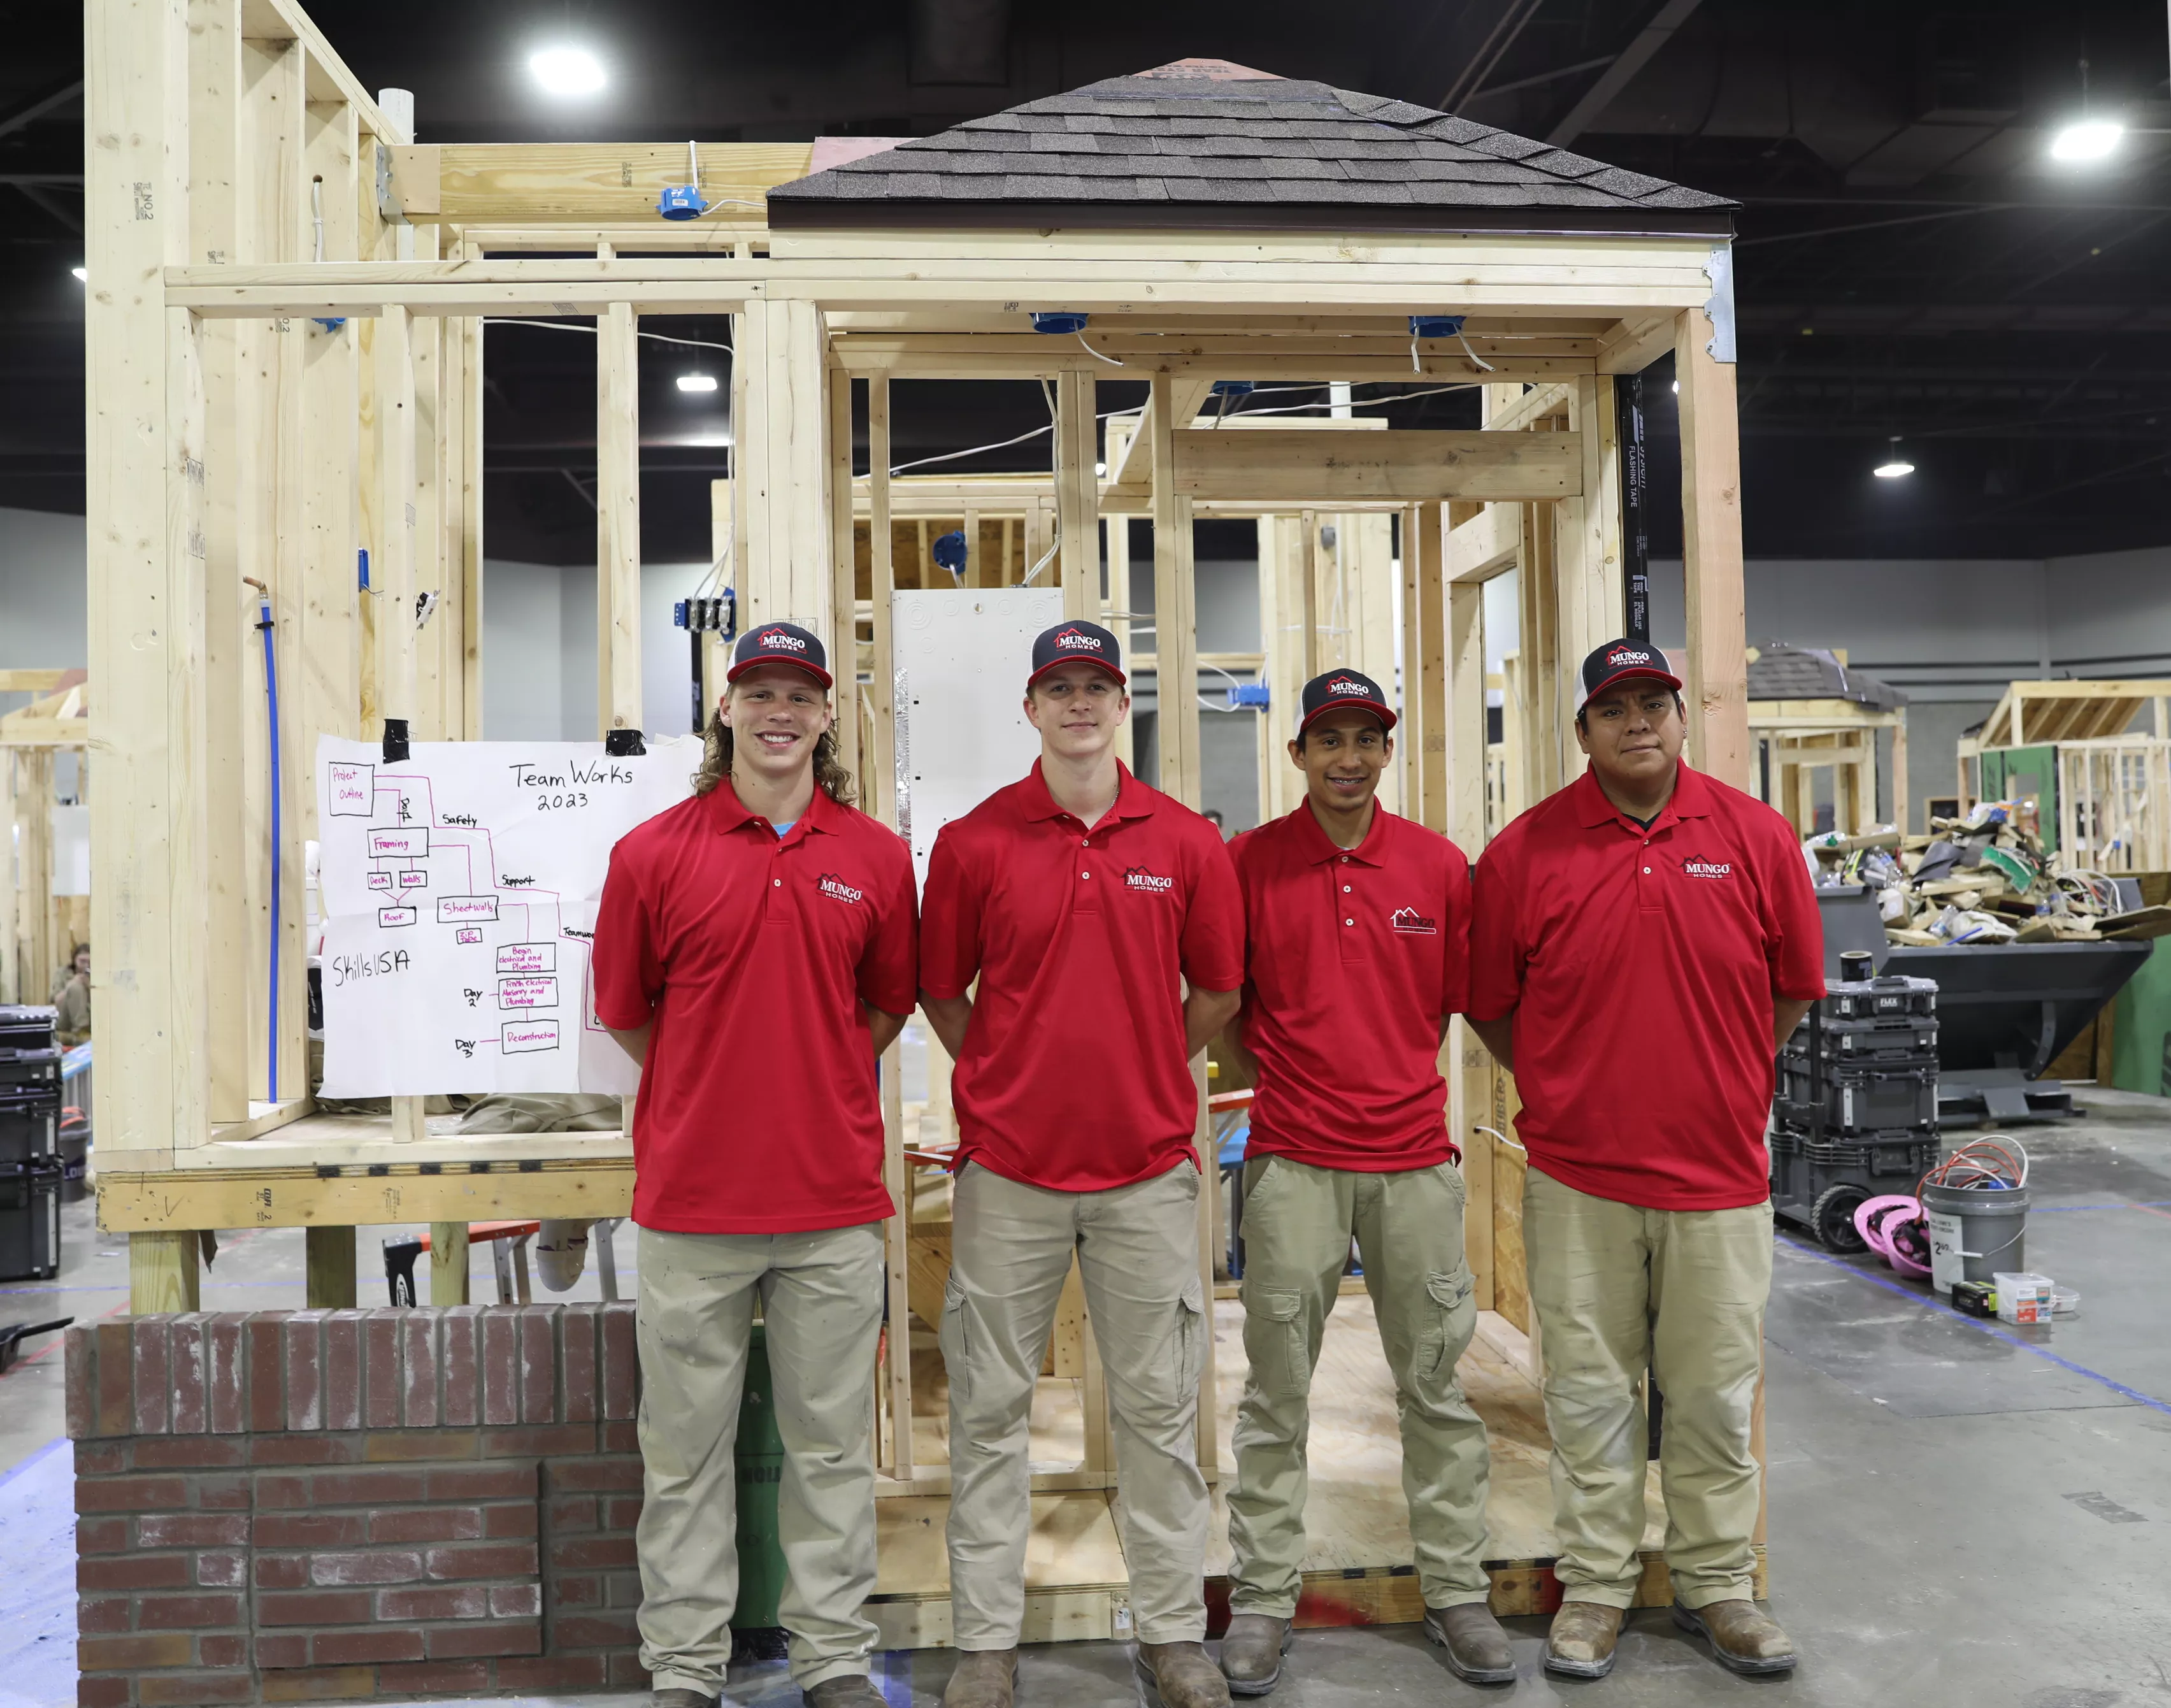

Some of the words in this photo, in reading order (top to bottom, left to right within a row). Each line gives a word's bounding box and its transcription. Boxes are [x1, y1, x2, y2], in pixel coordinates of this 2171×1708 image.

[144, 194, 154, 220] NO.2
[1629, 446, 1637, 485] FLASHING
[763, 636, 805, 649] MUNGO
[1059, 636, 1101, 647] MUNGO
[1610, 652, 1649, 664] MUNGO
[1330, 682, 1369, 694] MUNGO
[509, 763, 566, 787] Team
[538, 793, 588, 811] 2023
[443, 814, 477, 828] Safety
[374, 836, 409, 850] Framing
[1686, 863, 1730, 874] MUNGO
[502, 875, 536, 887] Support
[1126, 875, 1171, 887] MUNGO
[820, 879, 862, 900] MUNGO
[826, 892, 854, 904] HOMES
[512, 946, 532, 956] Begin
[528, 952, 542, 961] and
[464, 988, 483, 1000] Day
[502, 988, 527, 997] Masonry
[530, 986, 545, 994] and
[468, 998, 476, 1007] 2
[507, 1031, 556, 1042] Deconstruction
[455, 1039, 476, 1050] Day
[462, 1049, 473, 1058] 3
